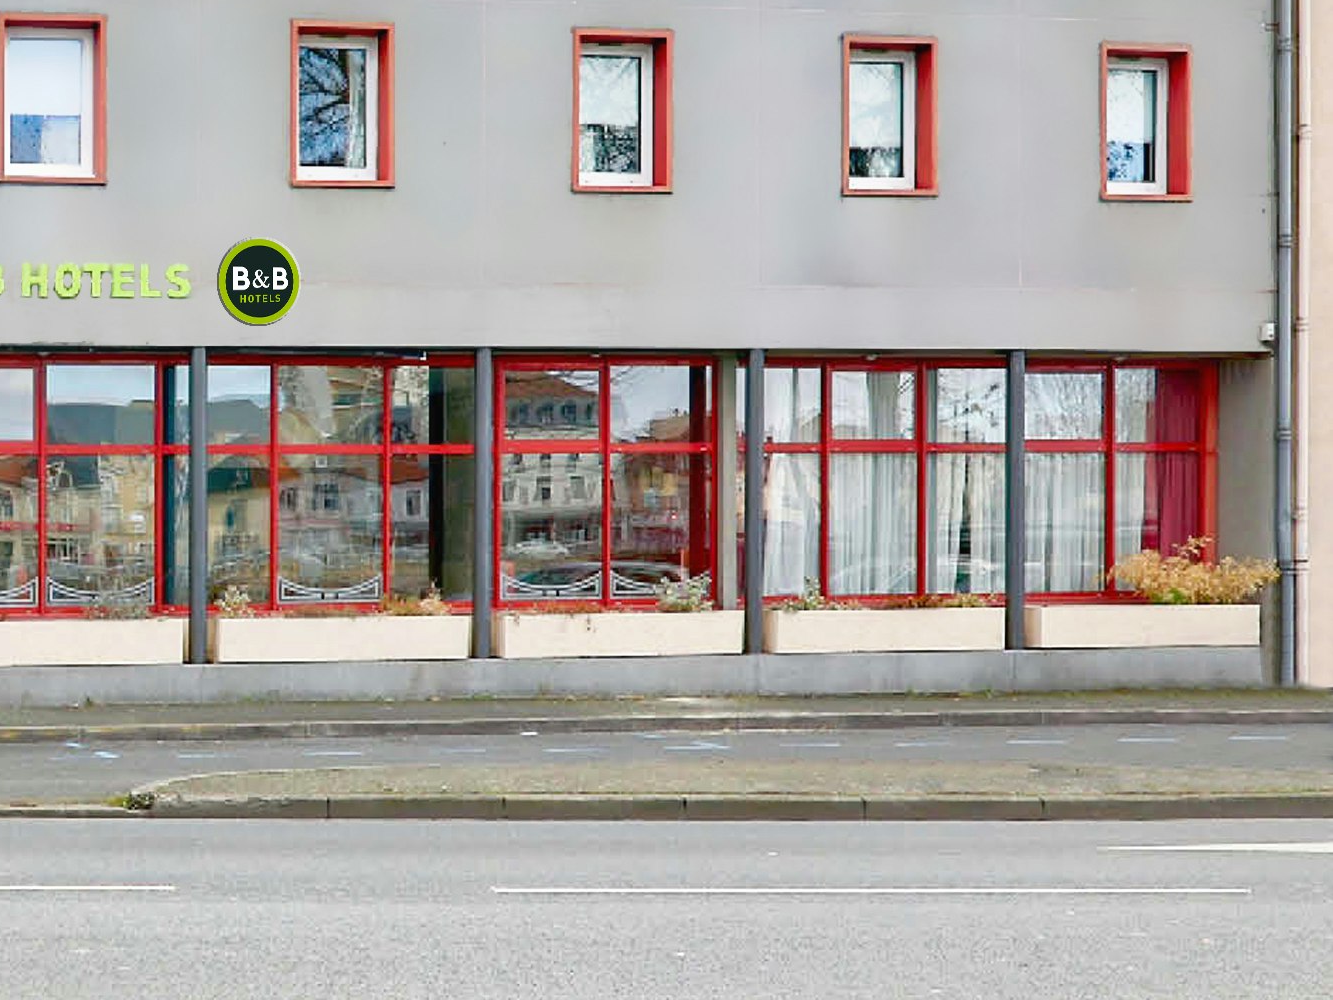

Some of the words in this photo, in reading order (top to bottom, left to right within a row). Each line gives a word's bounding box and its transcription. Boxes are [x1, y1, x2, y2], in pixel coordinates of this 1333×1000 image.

[21, 263, 192, 299] HOTELS
[232, 266, 289, 291] B&B
[239, 294, 281, 303] HOTELS
